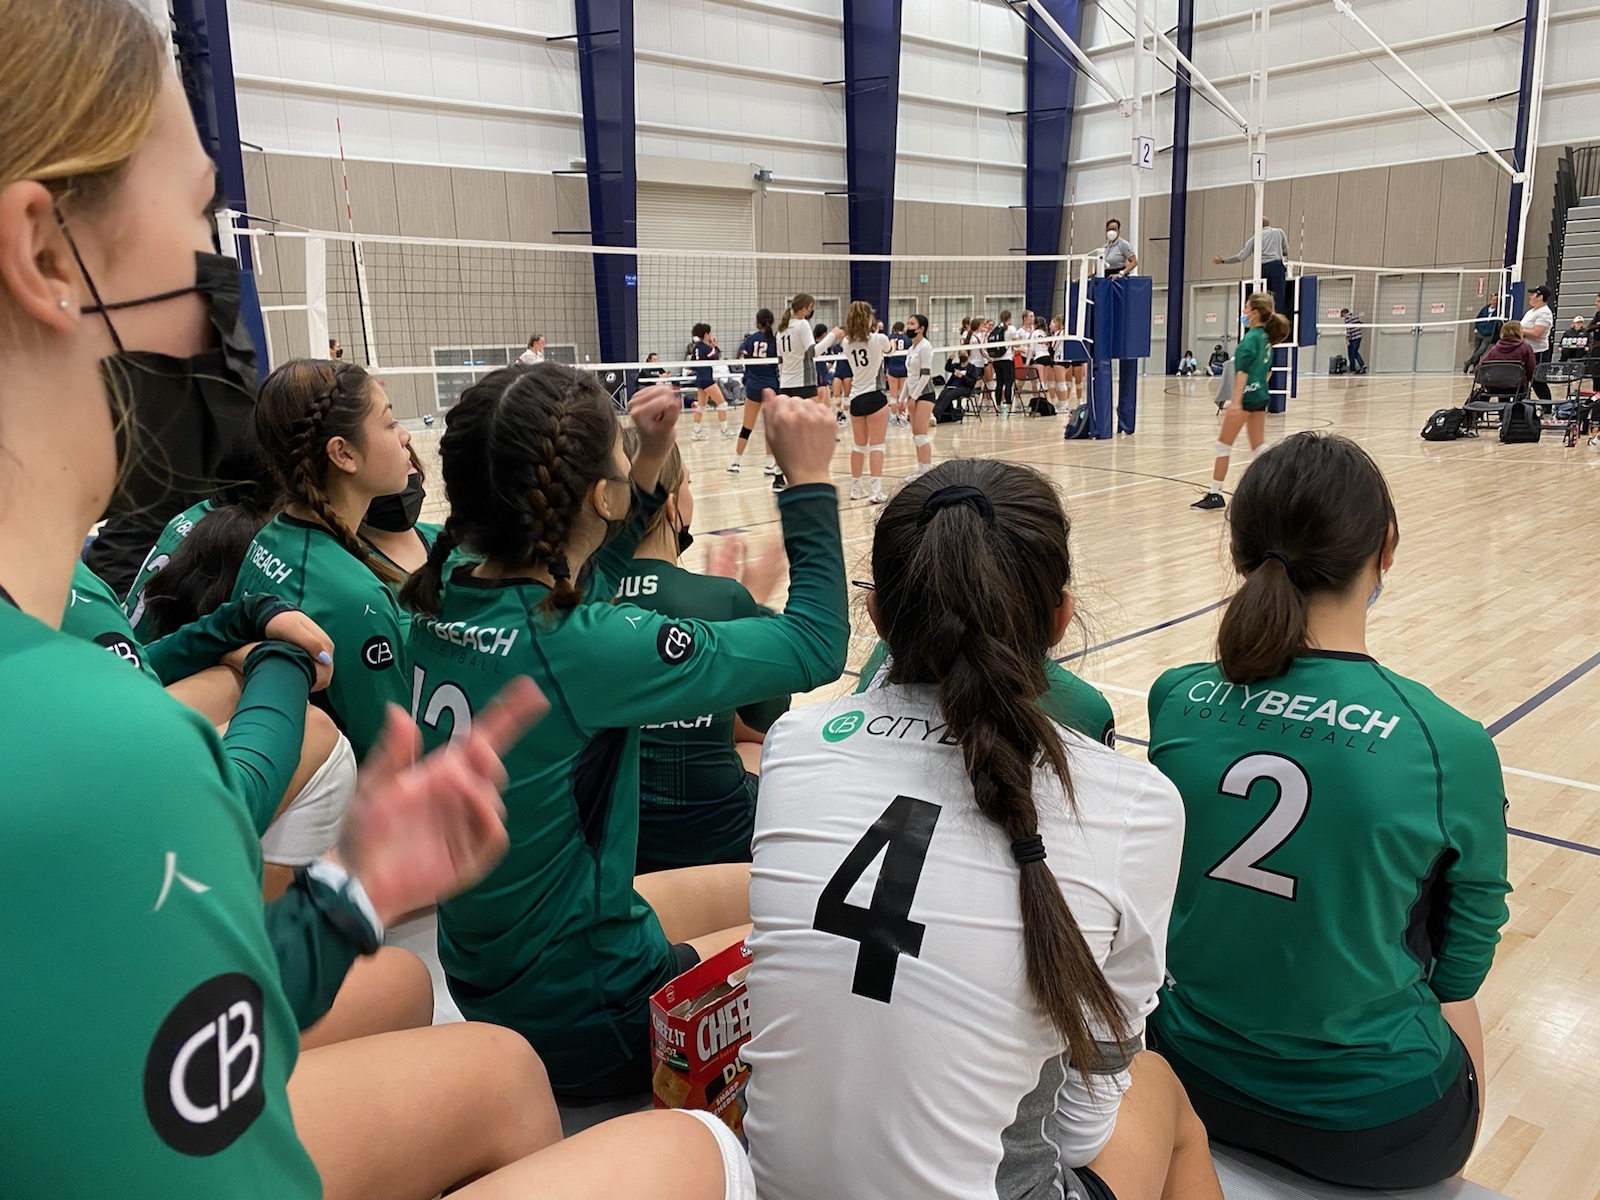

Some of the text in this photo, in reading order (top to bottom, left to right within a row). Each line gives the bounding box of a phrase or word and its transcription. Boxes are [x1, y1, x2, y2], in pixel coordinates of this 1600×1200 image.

[1143, 142, 1150, 164] 2
[1256, 157, 1262, 176] 1
[752, 340, 768, 358] 12
[781, 334, 792, 352] 11
[851, 348, 869, 367] 13
[1183, 705, 1377, 754] VOLLEYBALL
[1204, 750, 1312, 902] 2
[812, 794, 942, 1004] 4
